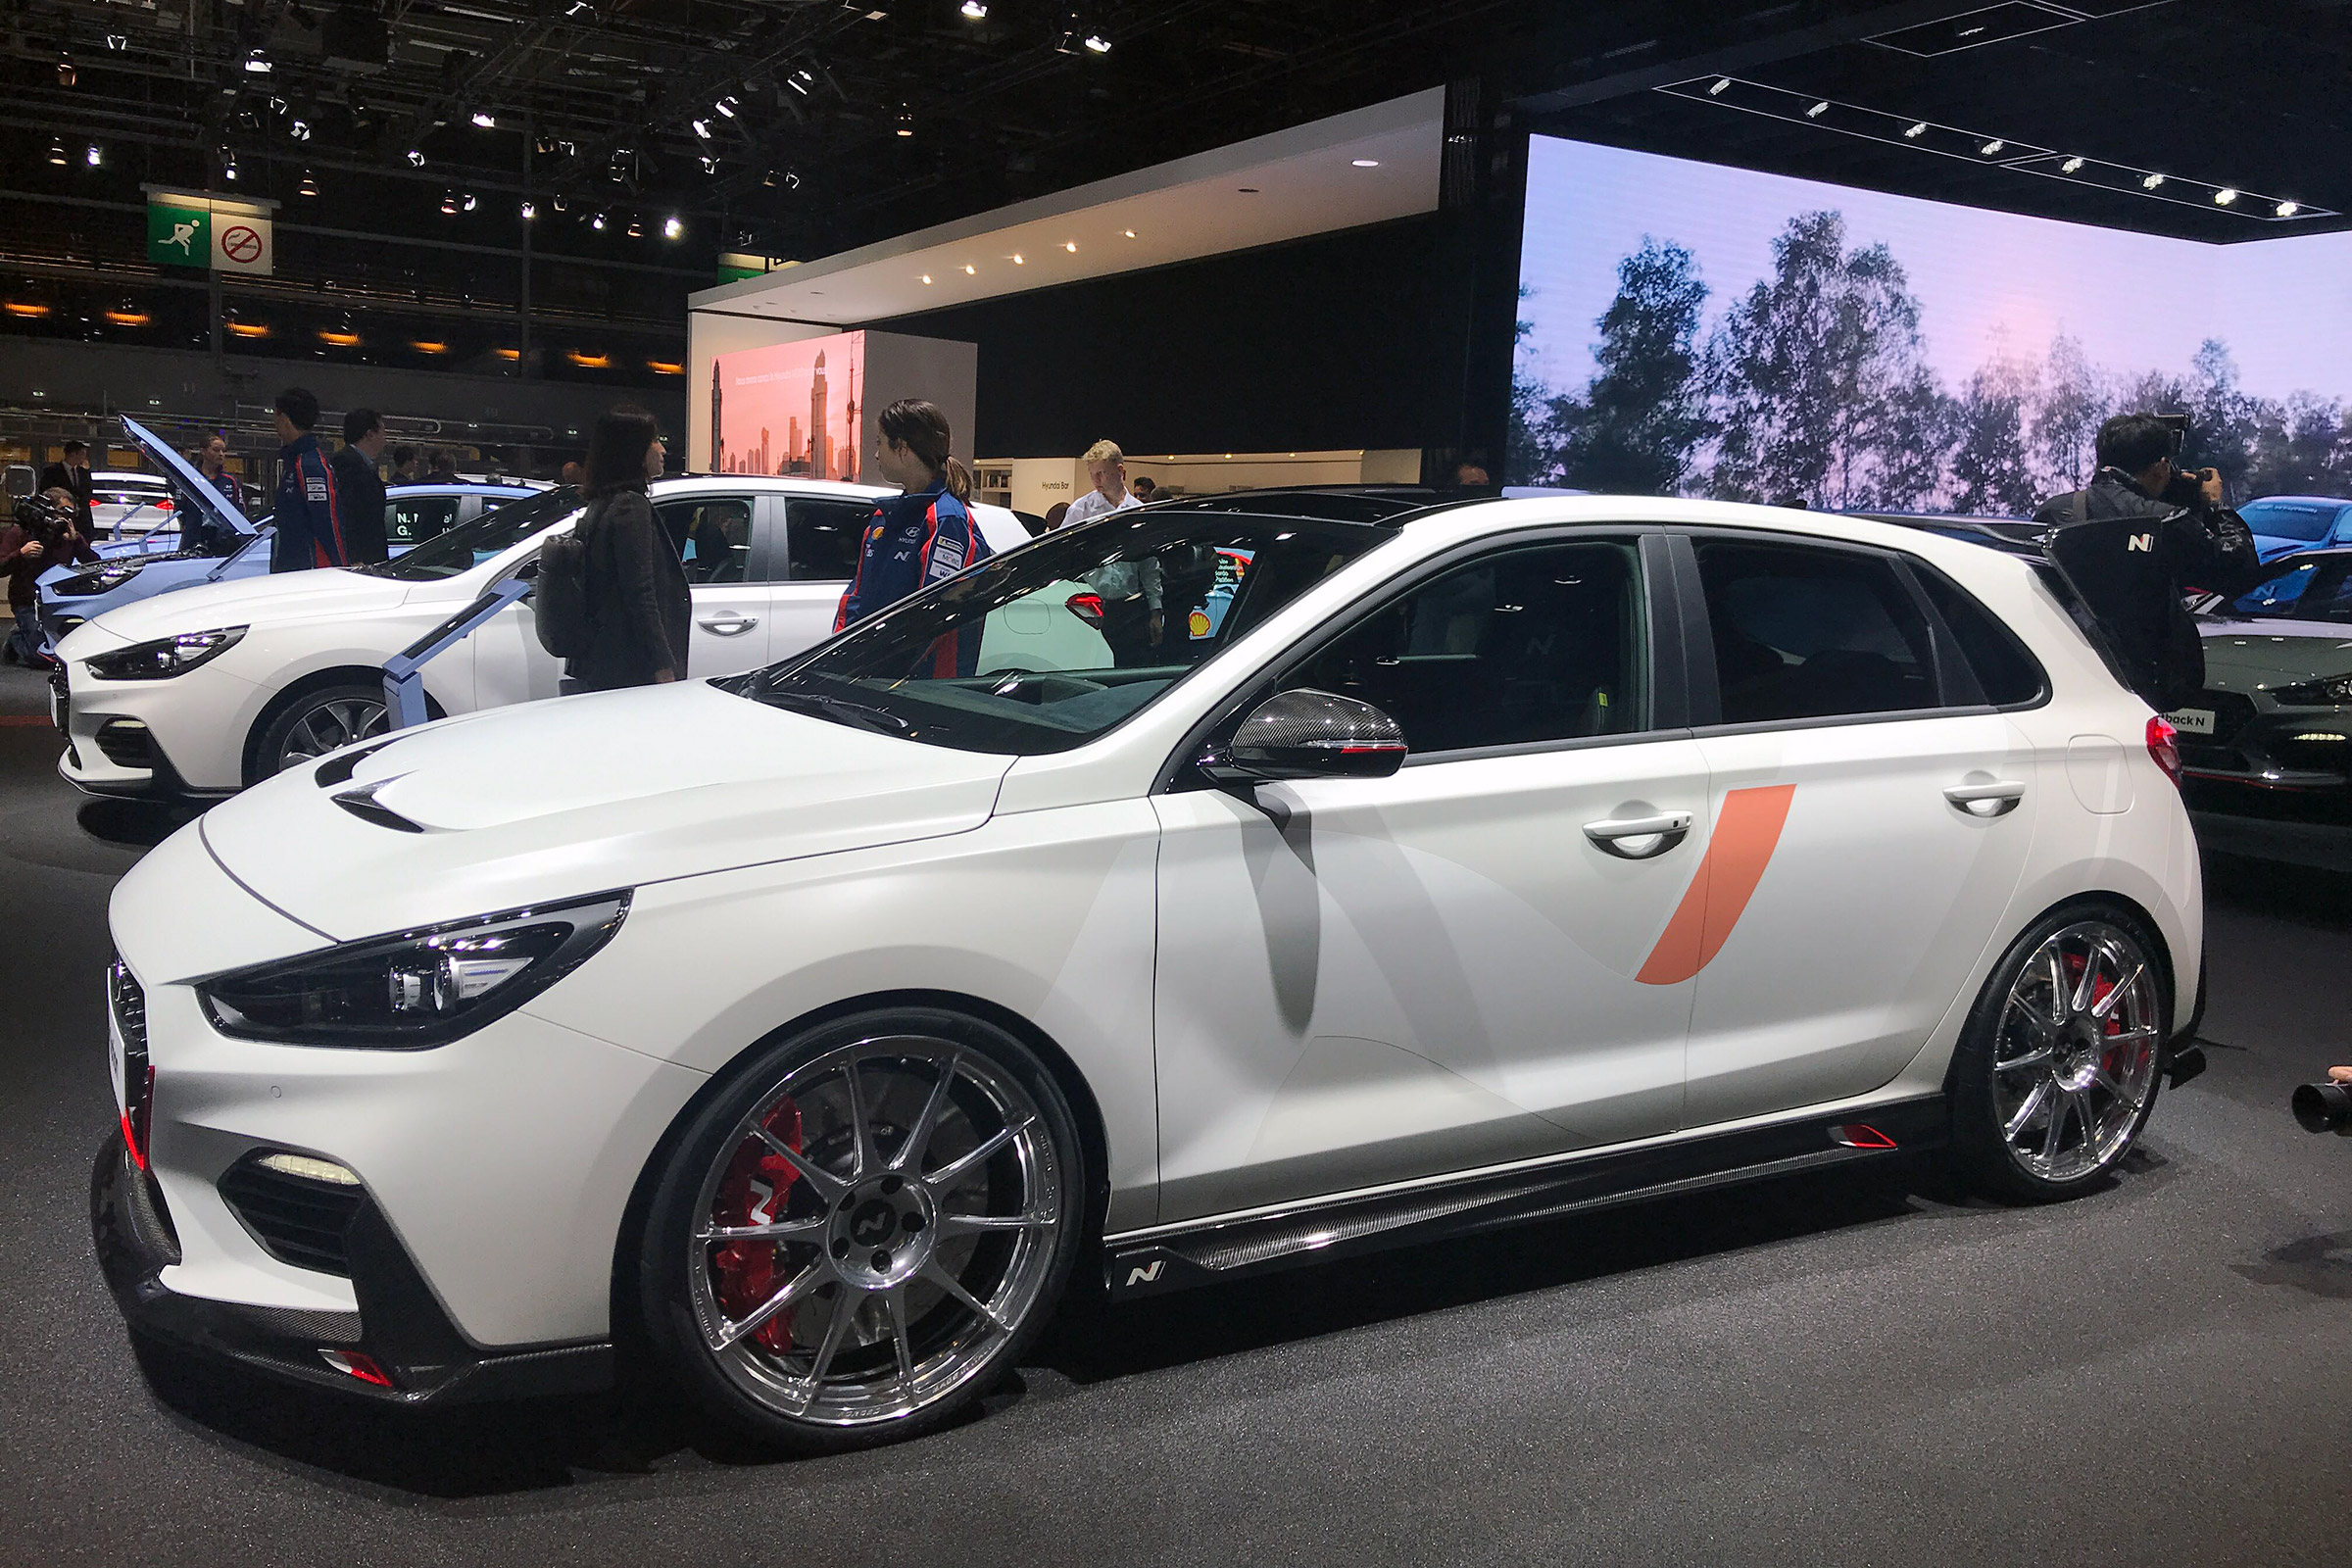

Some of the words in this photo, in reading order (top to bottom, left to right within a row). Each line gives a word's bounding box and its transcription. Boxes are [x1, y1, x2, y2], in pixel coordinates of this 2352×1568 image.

[1042, 481, 1059, 491] Hyundai
[2195, 716, 2205, 726] N
[1126, 1260, 1166, 1286] N
